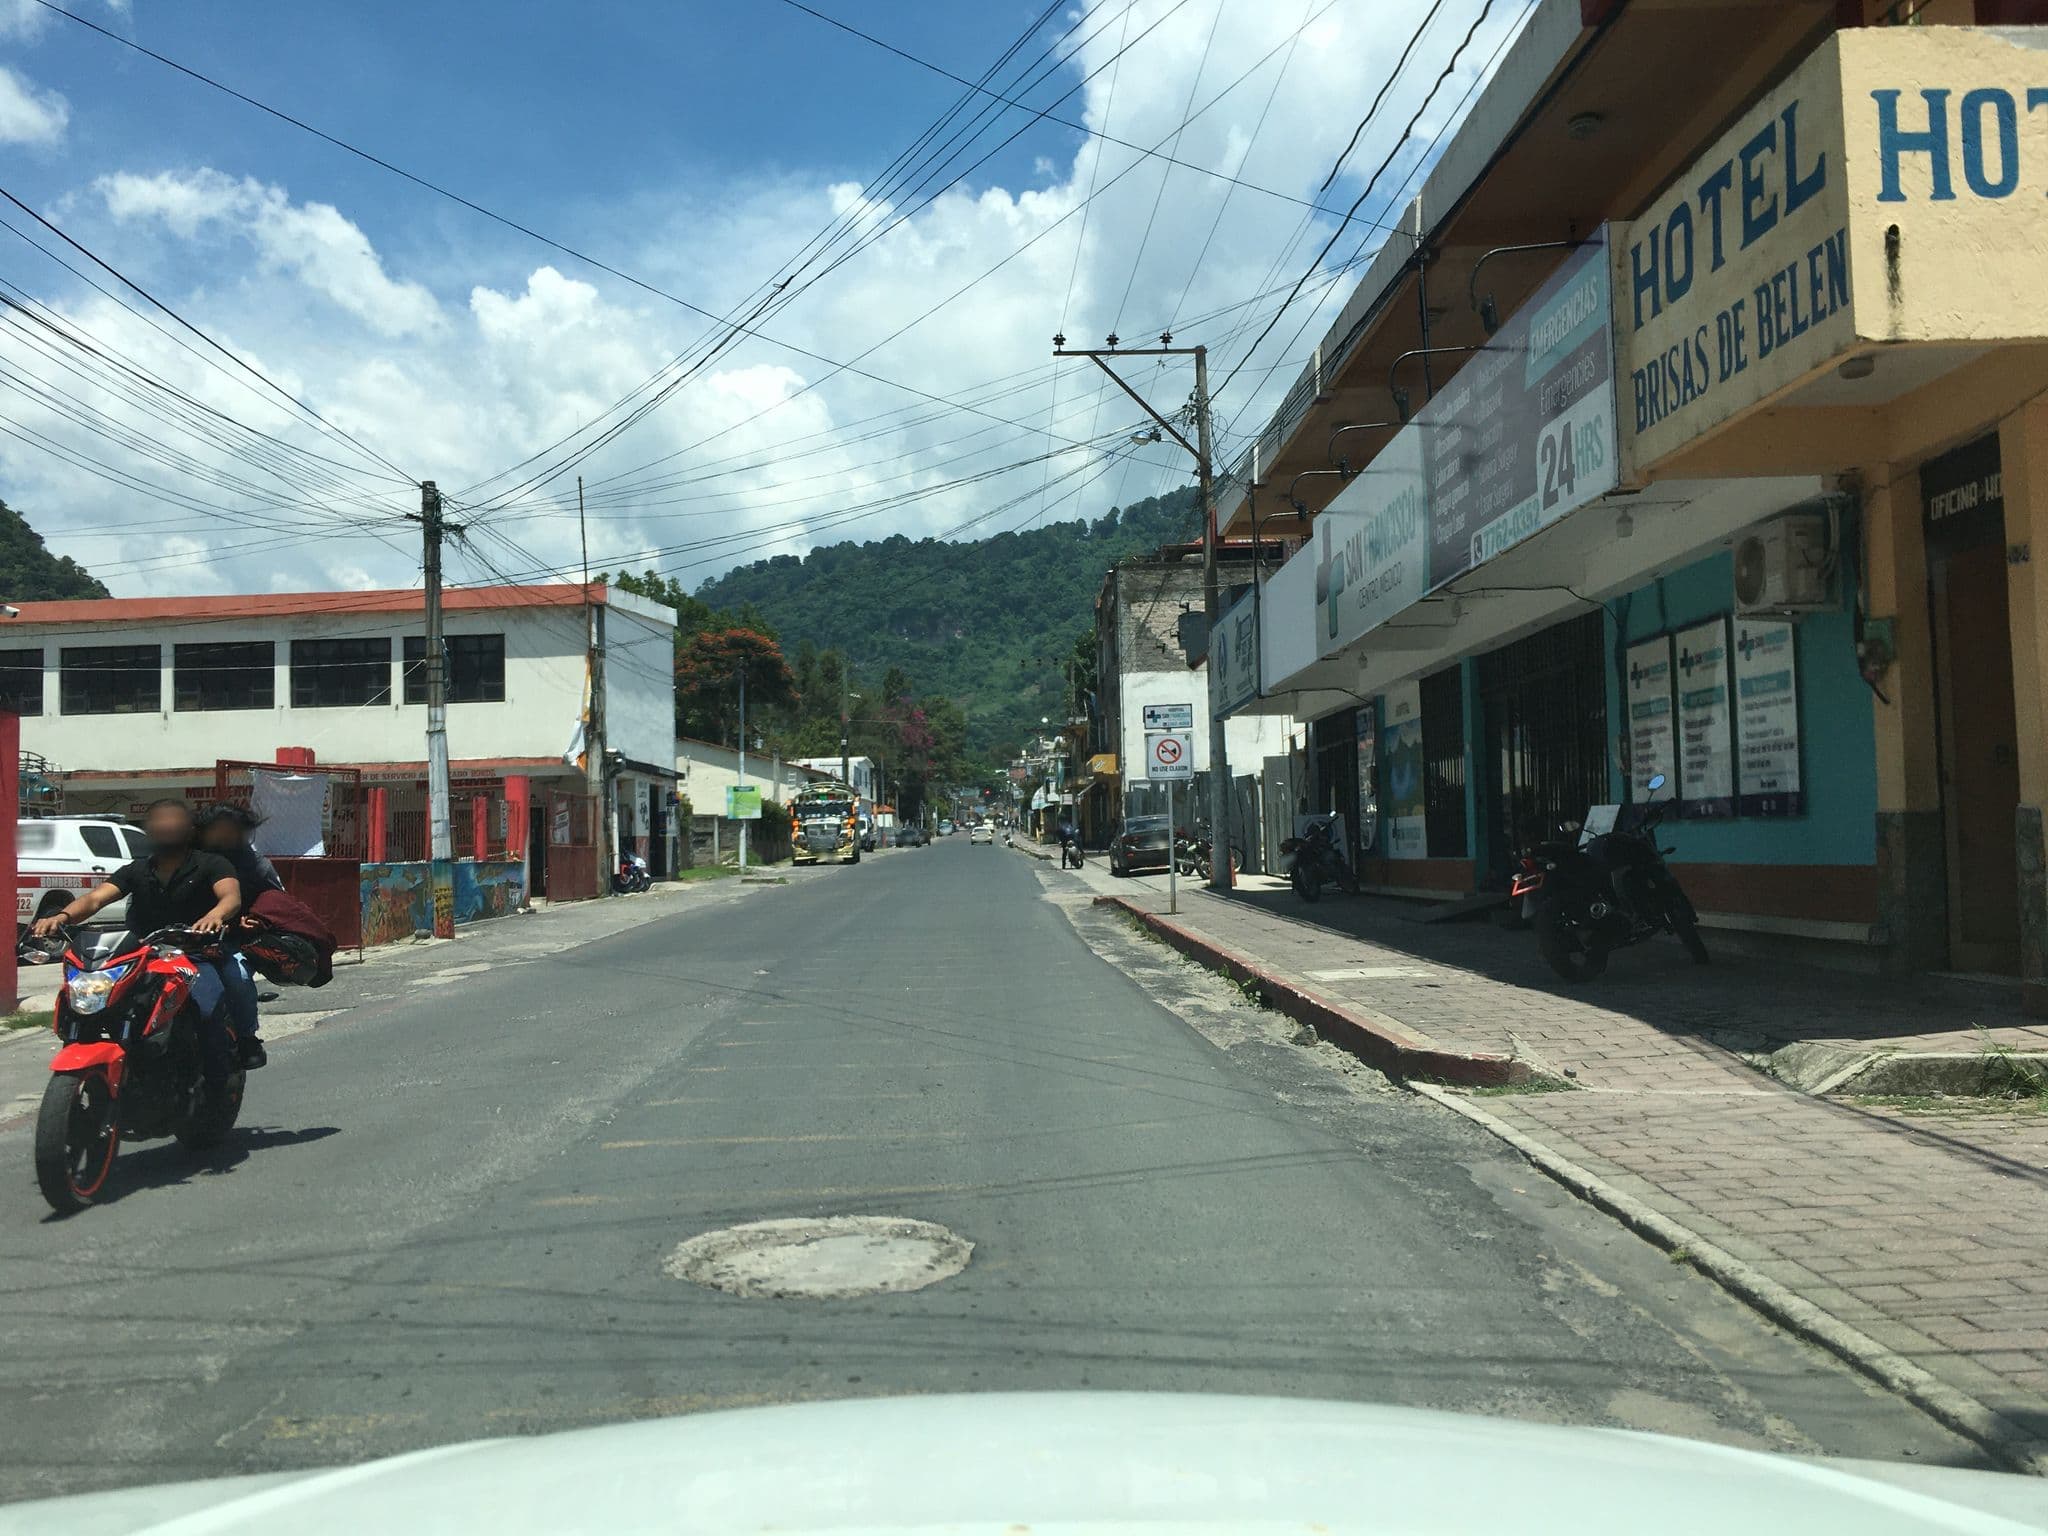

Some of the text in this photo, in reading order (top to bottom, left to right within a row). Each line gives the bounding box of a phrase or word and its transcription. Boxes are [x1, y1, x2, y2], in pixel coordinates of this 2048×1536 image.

[1870, 87, 2048, 203] HO
[1631, 99, 1826, 331] HOTEL
[1531, 277, 1597, 365] EMERGENCIAS
[1632, 324, 1710, 434] BRISAS
[1717, 298, 1747, 383] DE
[1754, 227, 1849, 359] BELEN
[1540, 351, 1596, 415] Emergencies
[1541, 414, 1603, 511] 24 HRS
[1930, 481, 1979, 520] OFICINA
[1345, 529, 1364, 587] SAN
[40, 877, 83, 889] BOMBEROS
